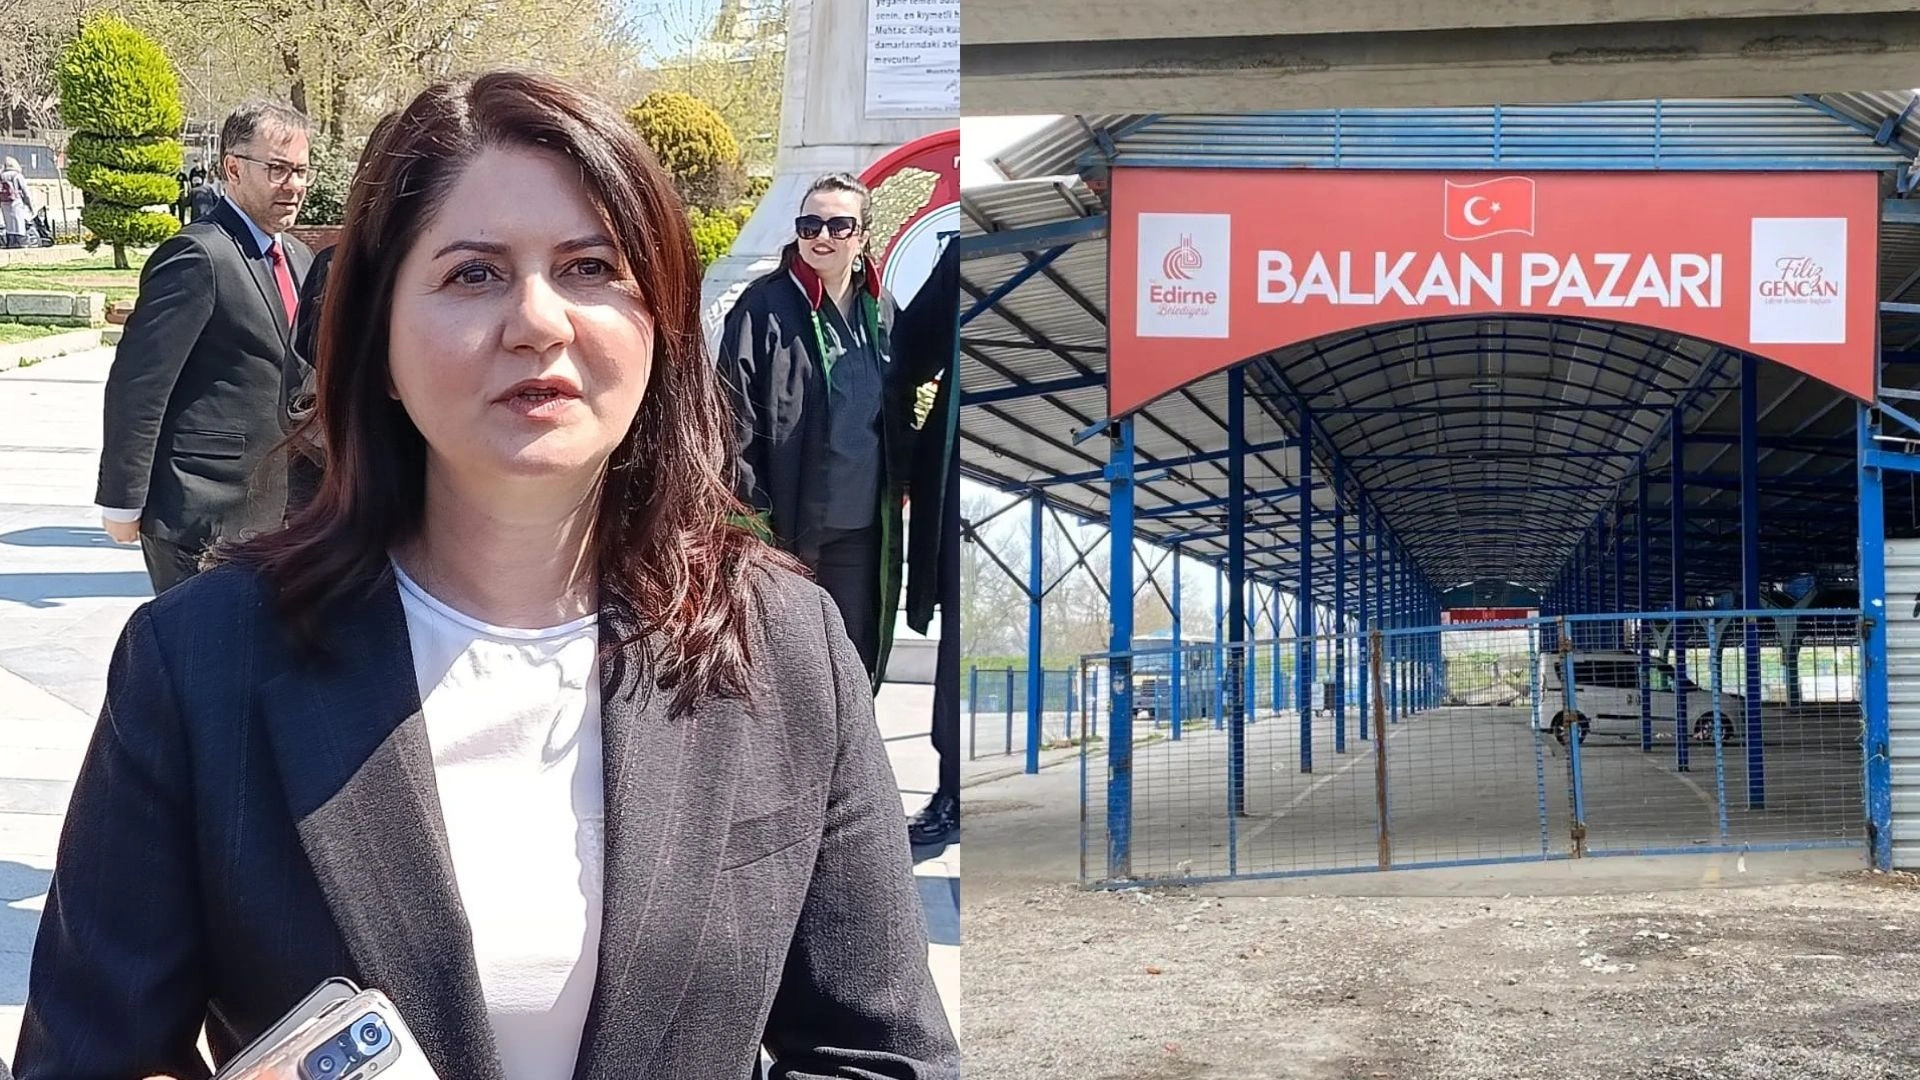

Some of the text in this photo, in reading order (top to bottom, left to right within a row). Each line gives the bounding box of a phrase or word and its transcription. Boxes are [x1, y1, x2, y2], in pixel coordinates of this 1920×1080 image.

[904, 12, 915, 20] en
[1258, 250, 1722, 307] BALKAN PAZARI
[1775, 256, 1824, 289] Filiz
[1150, 285, 1218, 305] Edirne
[1759, 280, 1839, 297] GENCAN
